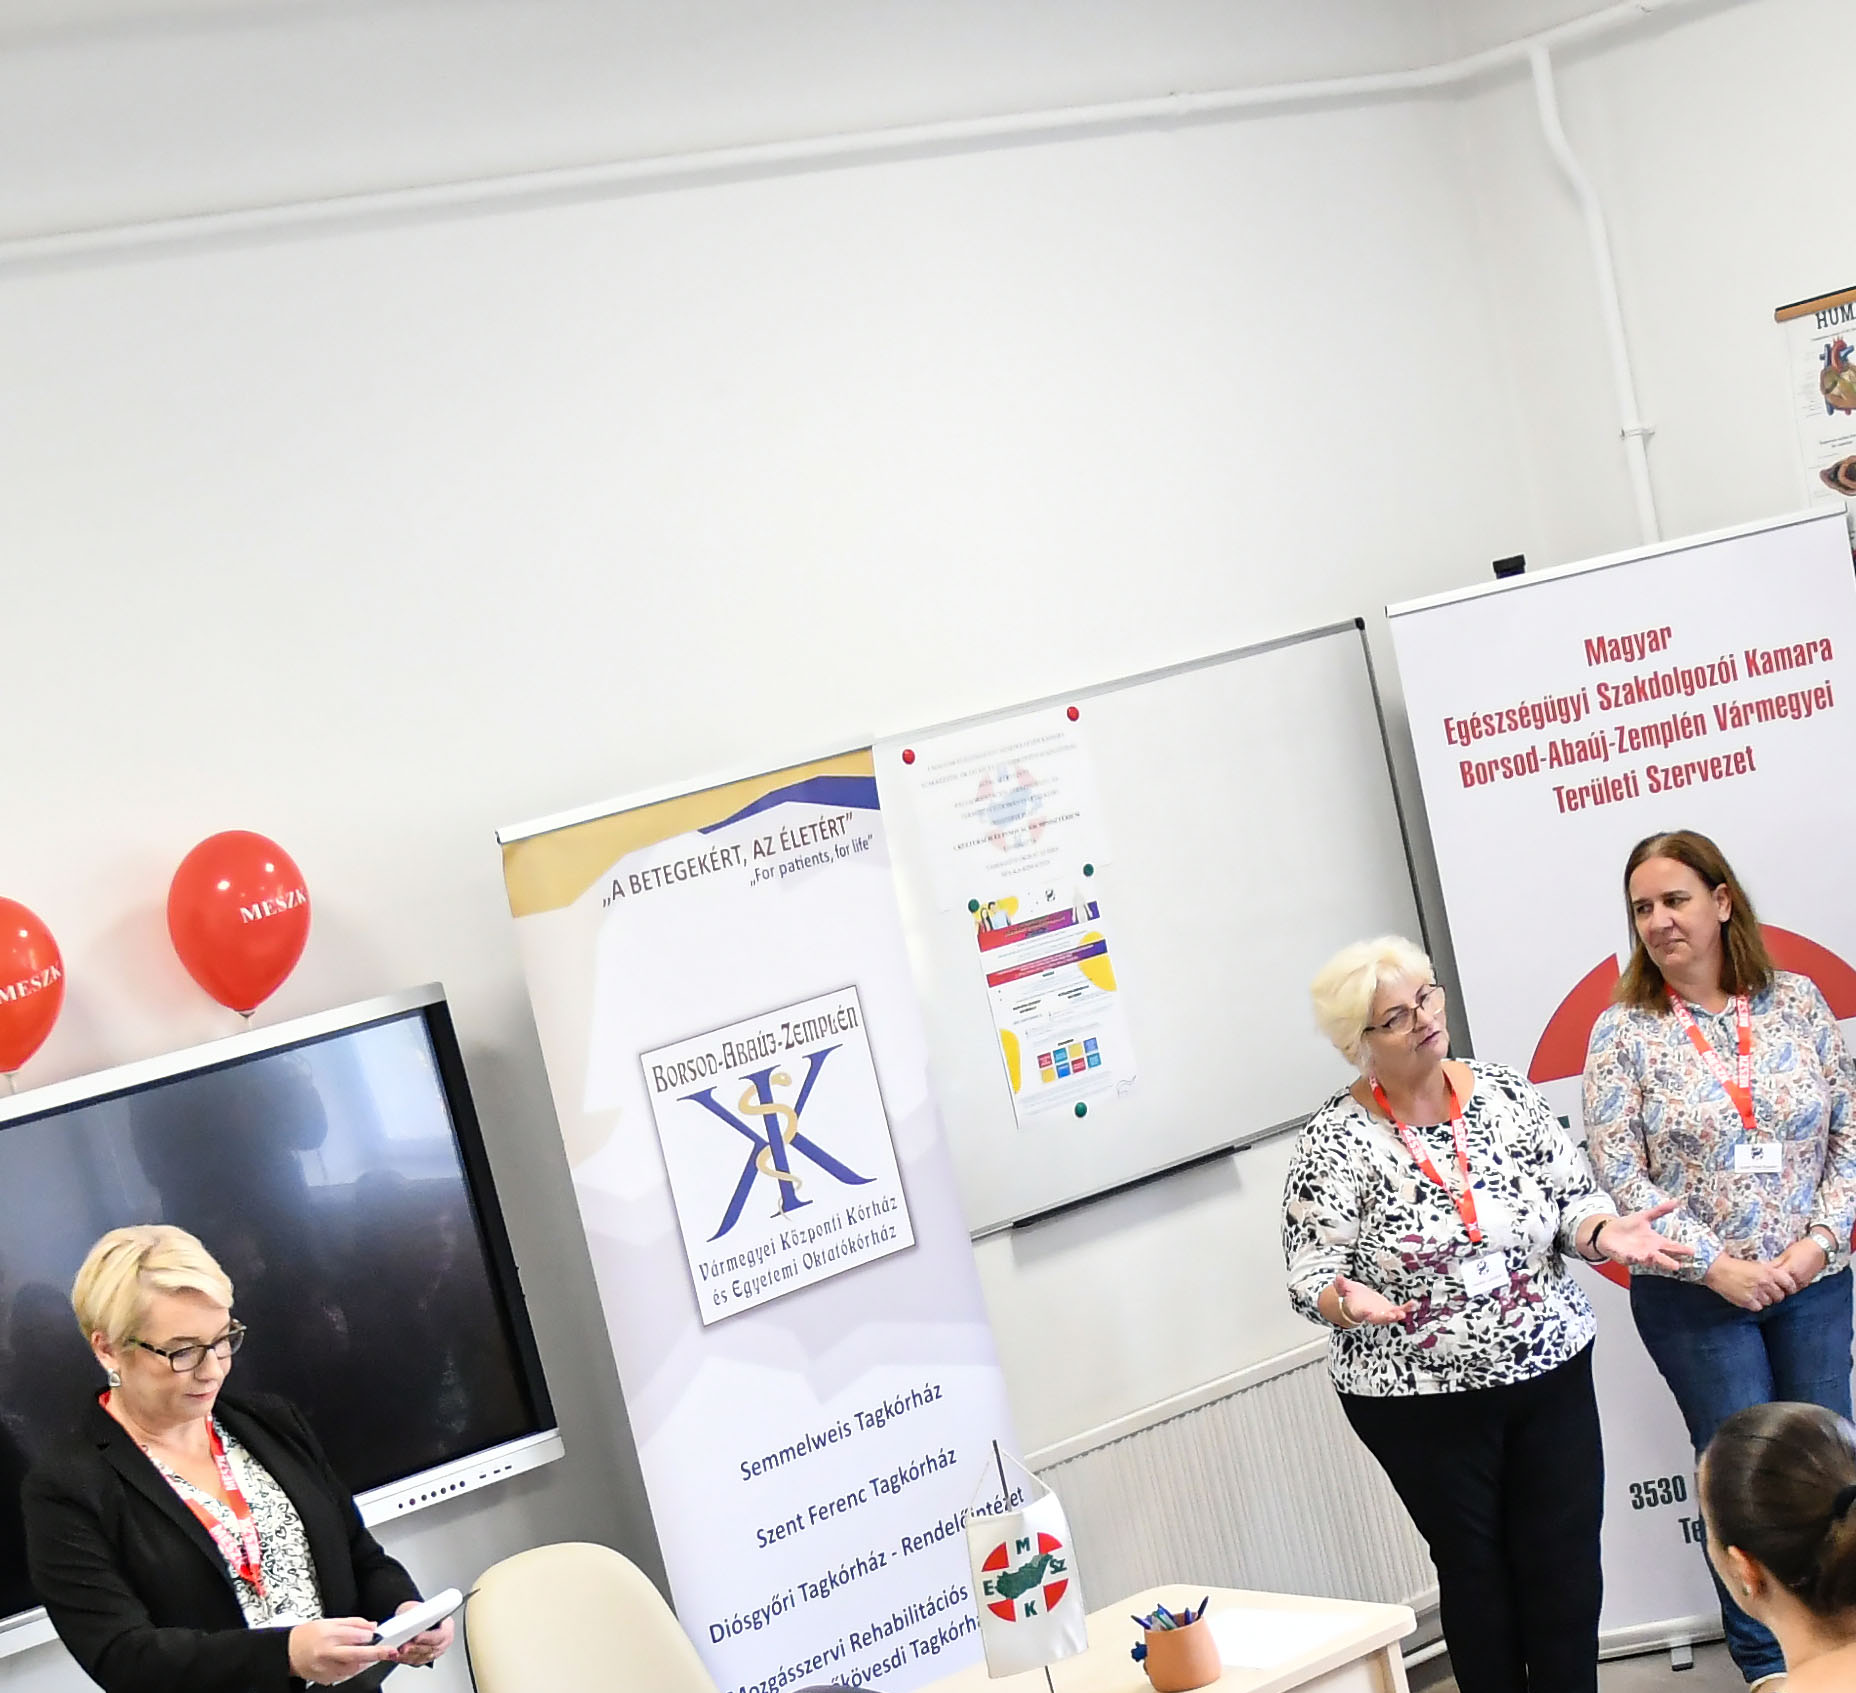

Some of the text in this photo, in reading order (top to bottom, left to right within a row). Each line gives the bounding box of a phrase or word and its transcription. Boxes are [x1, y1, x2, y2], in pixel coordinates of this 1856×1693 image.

[1583, 625, 1673, 667] Magyar
[1443, 637, 1834, 746] Egészségügyi Szakdolgozói Kamara
[1458, 678, 1835, 789] Borsod-Abaúj-Zemplén Vármegyei
[1553, 744, 1757, 815] Területi Szervezet
[629, 844, 748, 896] BETEGEKÉRT,
[752, 835, 777, 861] AZ
[779, 849, 831, 881] patients,
[834, 840, 852, 862] for
[239, 887, 308, 924] MESZK
[698, 1195, 899, 1282] Vármegyei Központi Kórház
[712, 1224, 898, 1307] és Egyetemi Oktatókórház
[739, 1382, 944, 1482] Semmelweis Tagkórház
[215, 1454, 239, 1491] MESZK
[756, 1446, 958, 1549] Szent Ferenc Tagkórház
[1629, 1475, 1688, 1510] 3530
[1015, 1537, 1031, 1555] M
[709, 1590, 797, 1645] Diósgyőri
[797, 1550, 888, 1604] Tagkórház
[849, 1583, 970, 1652] Rehabilitációs
[982, 1580, 995, 1596] E
[1024, 1600, 1038, 1618] K
